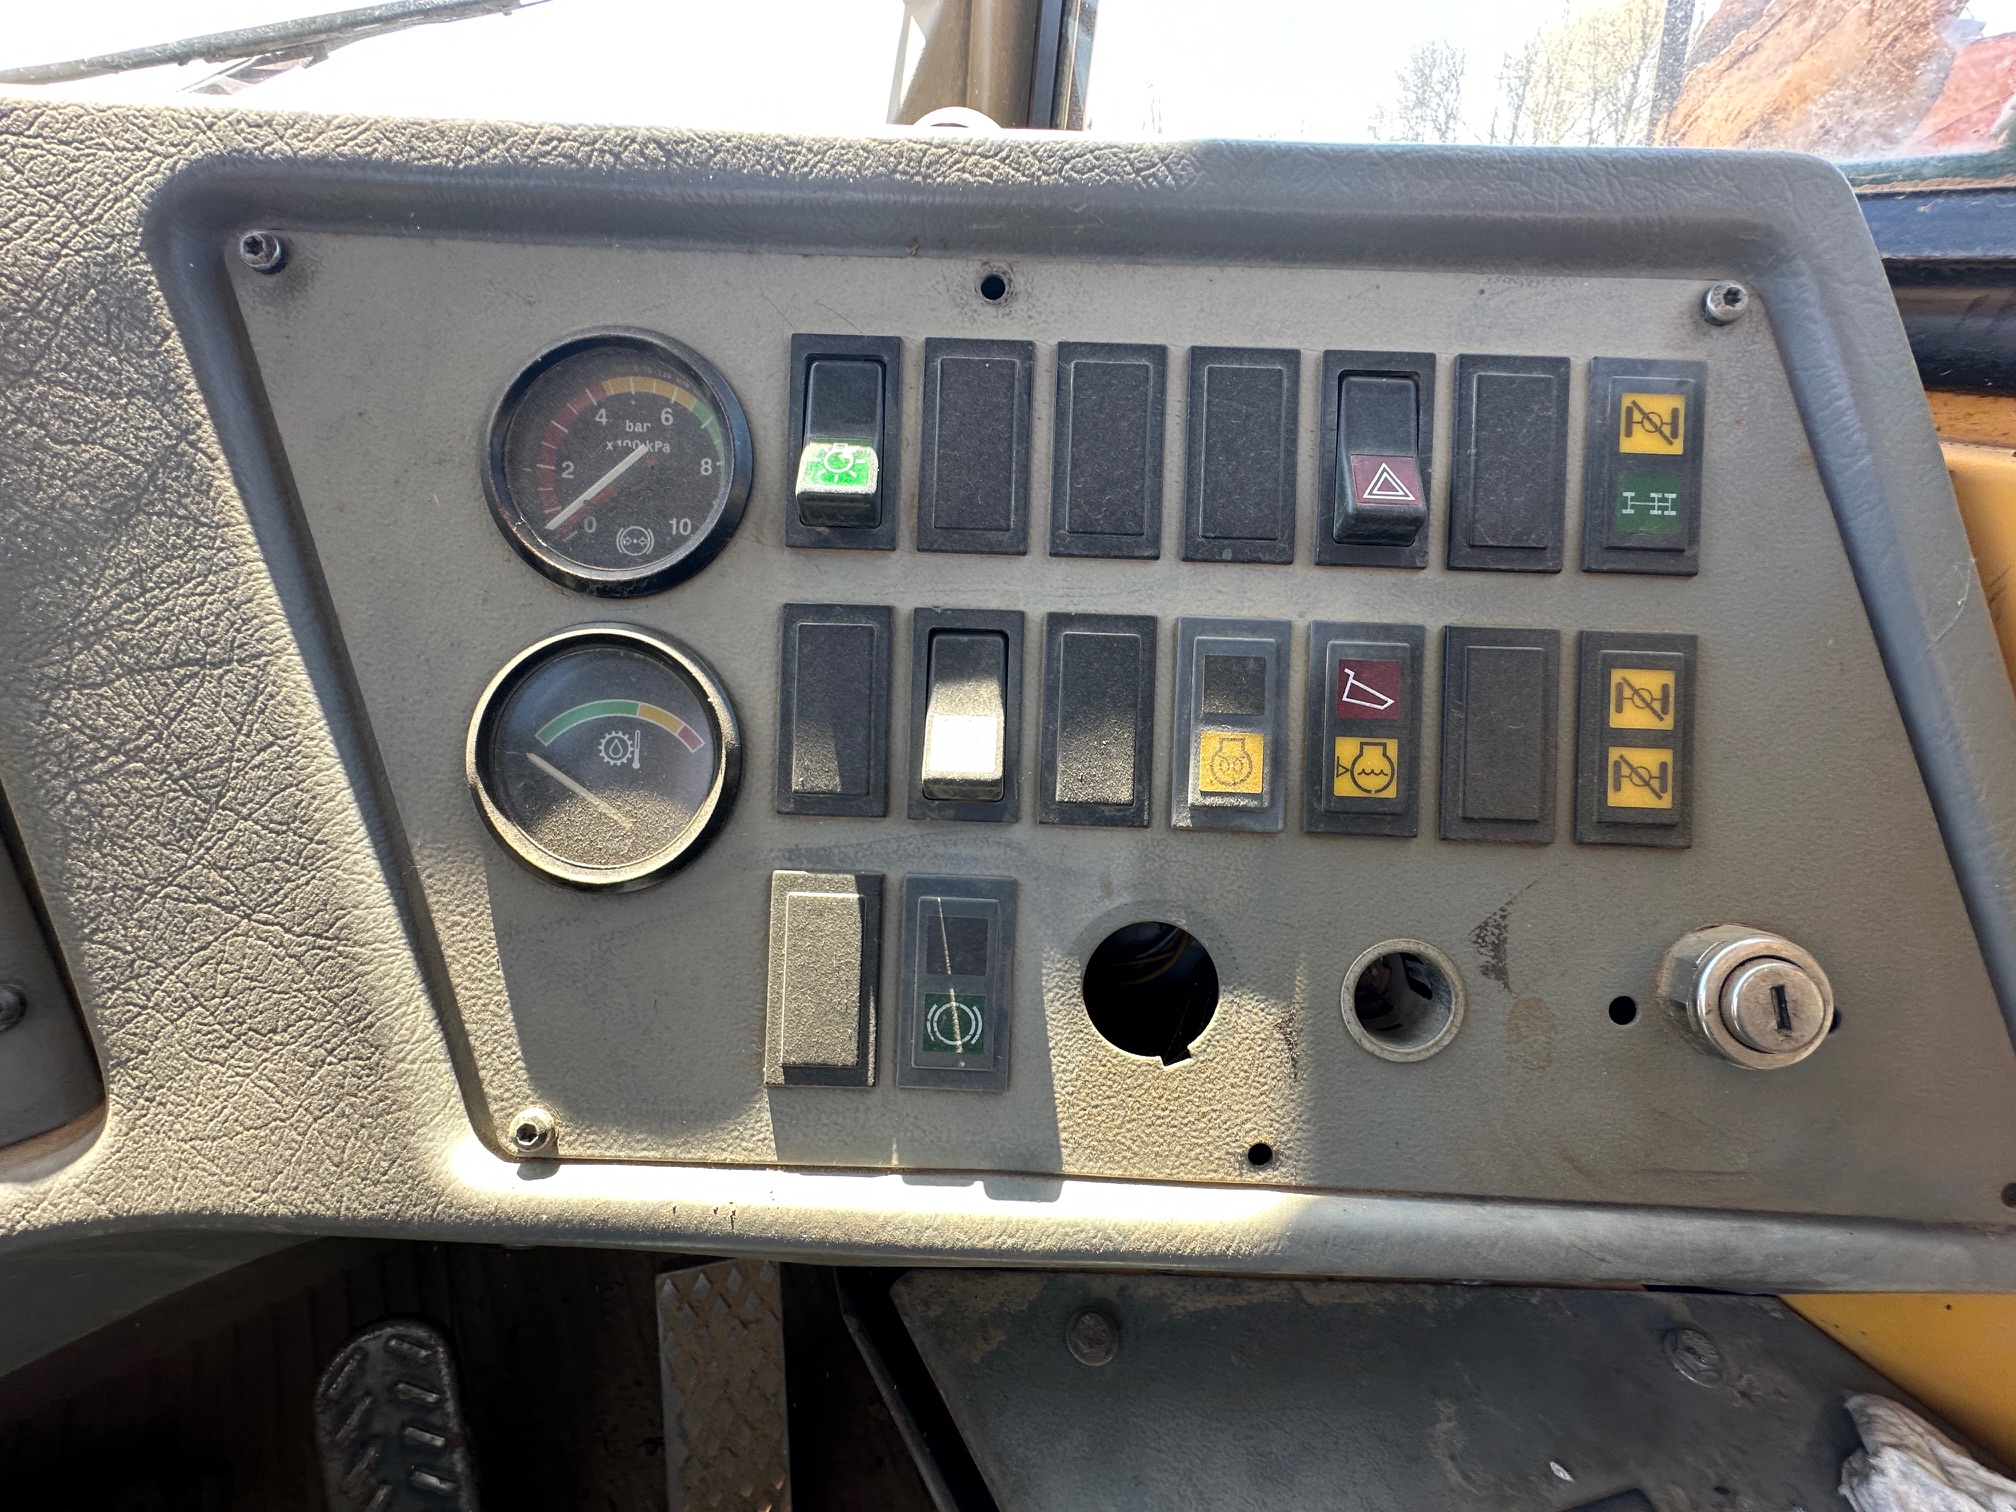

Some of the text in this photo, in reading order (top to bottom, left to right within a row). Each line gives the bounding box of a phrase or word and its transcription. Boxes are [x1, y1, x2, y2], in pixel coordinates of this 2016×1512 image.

[595, 408, 608, 426] 4
[625, 419, 651, 432] bar
[660, 408, 674, 426] 6
[646, 440, 671, 453] kPa
[561, 461, 575, 478] 2
[700, 458, 713, 476] 8
[583, 516, 597, 533] 0
[668, 518, 692, 536] 10
